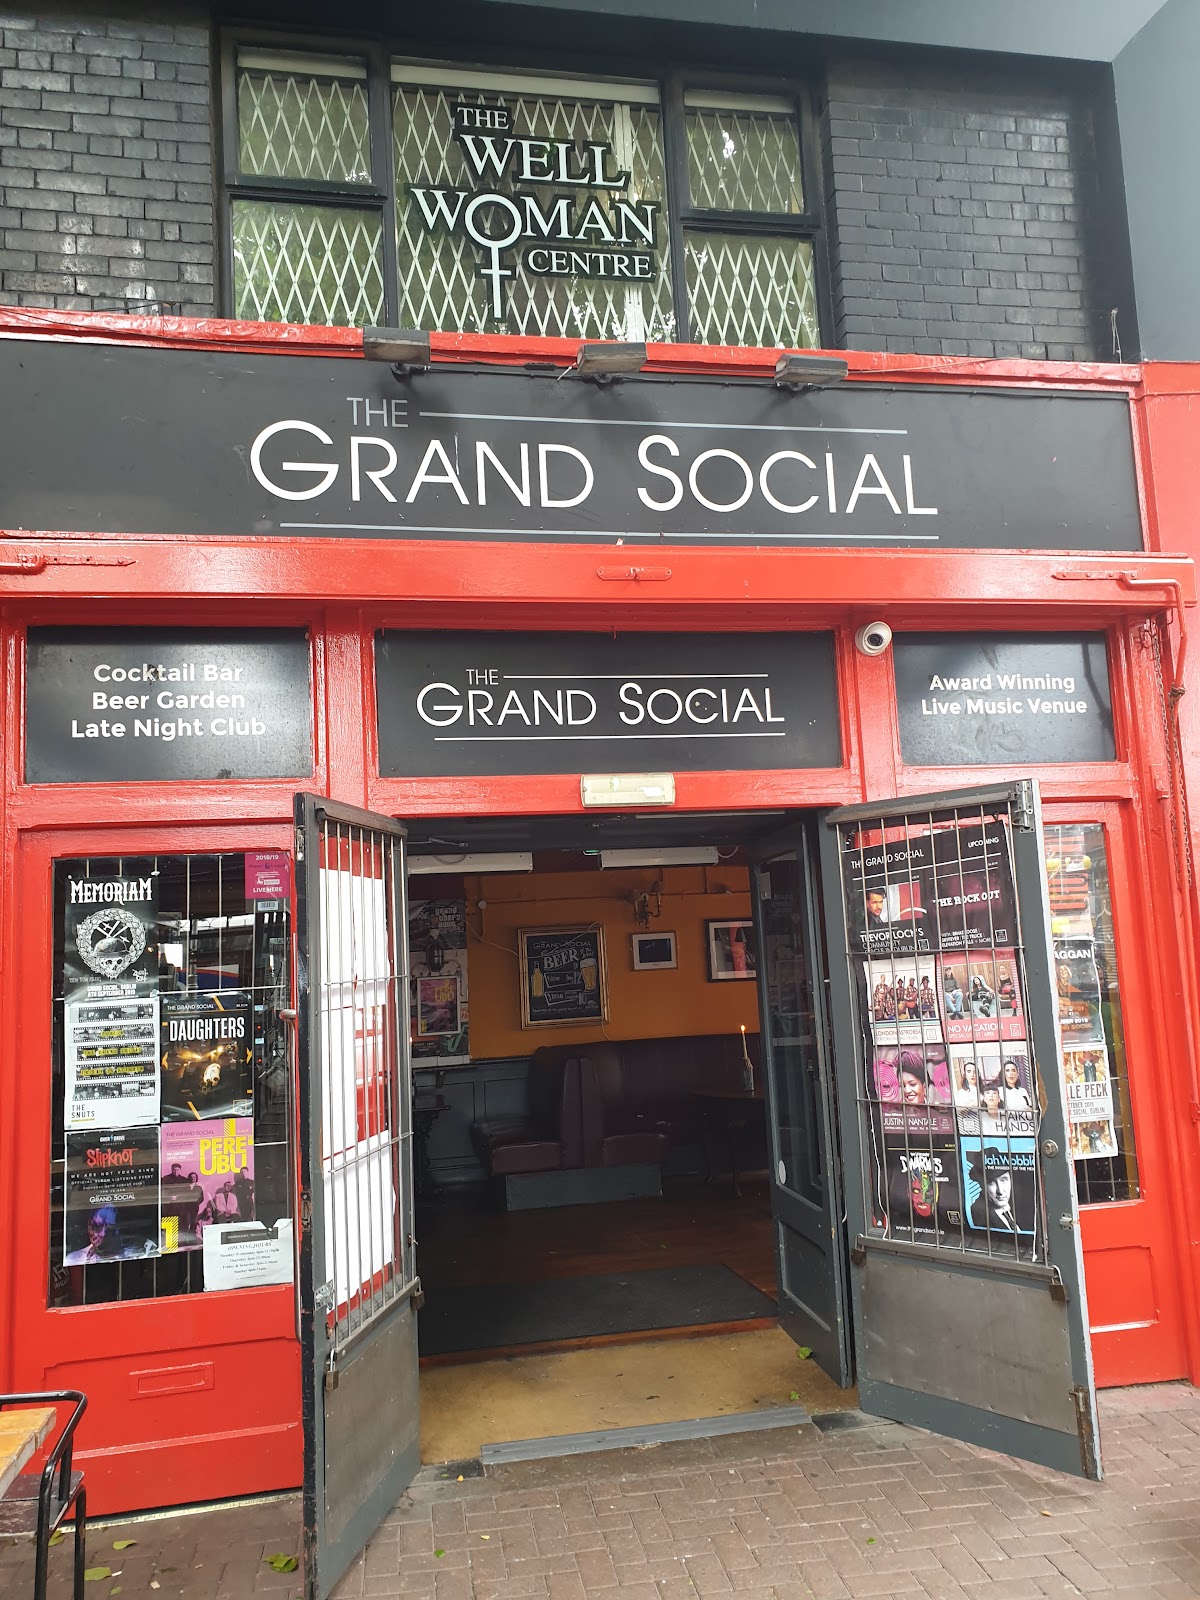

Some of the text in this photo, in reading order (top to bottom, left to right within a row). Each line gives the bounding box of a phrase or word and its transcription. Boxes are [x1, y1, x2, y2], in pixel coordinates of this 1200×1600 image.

[456, 106, 509, 130] THE
[460, 134, 628, 187] WELL
[410, 188, 656, 248] WOMAN
[527, 249, 652, 278] CENTRE
[347, 397, 409, 428] THE
[250, 420, 939, 516] GRAND SOCIAL
[93, 664, 243, 682] Cocktail Bar
[466, 669, 499, 685] THE
[929, 673, 1075, 693] Award Winning
[92, 691, 246, 710] Beer Garden
[416, 682, 785, 727] GRAND SOCIAL
[921, 697, 1087, 715] Live Music Venue
[71, 717, 266, 741] Late Night Club
[851, 860, 863, 870] TH
[894, 849, 925, 864] SOCIAL
[70, 878, 152, 906] MEMORIAM
[954, 892, 980, 906] ROCK
[863, 939, 900, 950] COMMUNTY
[543, 949, 579, 969] BEER
[169, 1017, 245, 1042] DAUGHTERS
[947, 1024, 963, 1033] NO
[1084, 1082, 1109, 1098] PECK
[71, 1111, 96, 1119] SNUTS
[883, 1118, 904, 1126] JUSTIN
[1000, 1111, 1033, 1122] HAIKU
[995, 1122, 1035, 1132] HANDS
[200, 1136, 247, 1156] PERE
[200, 1153, 247, 1176] UBU
[89, 1193, 136, 1203] GRAND SOCIAL
